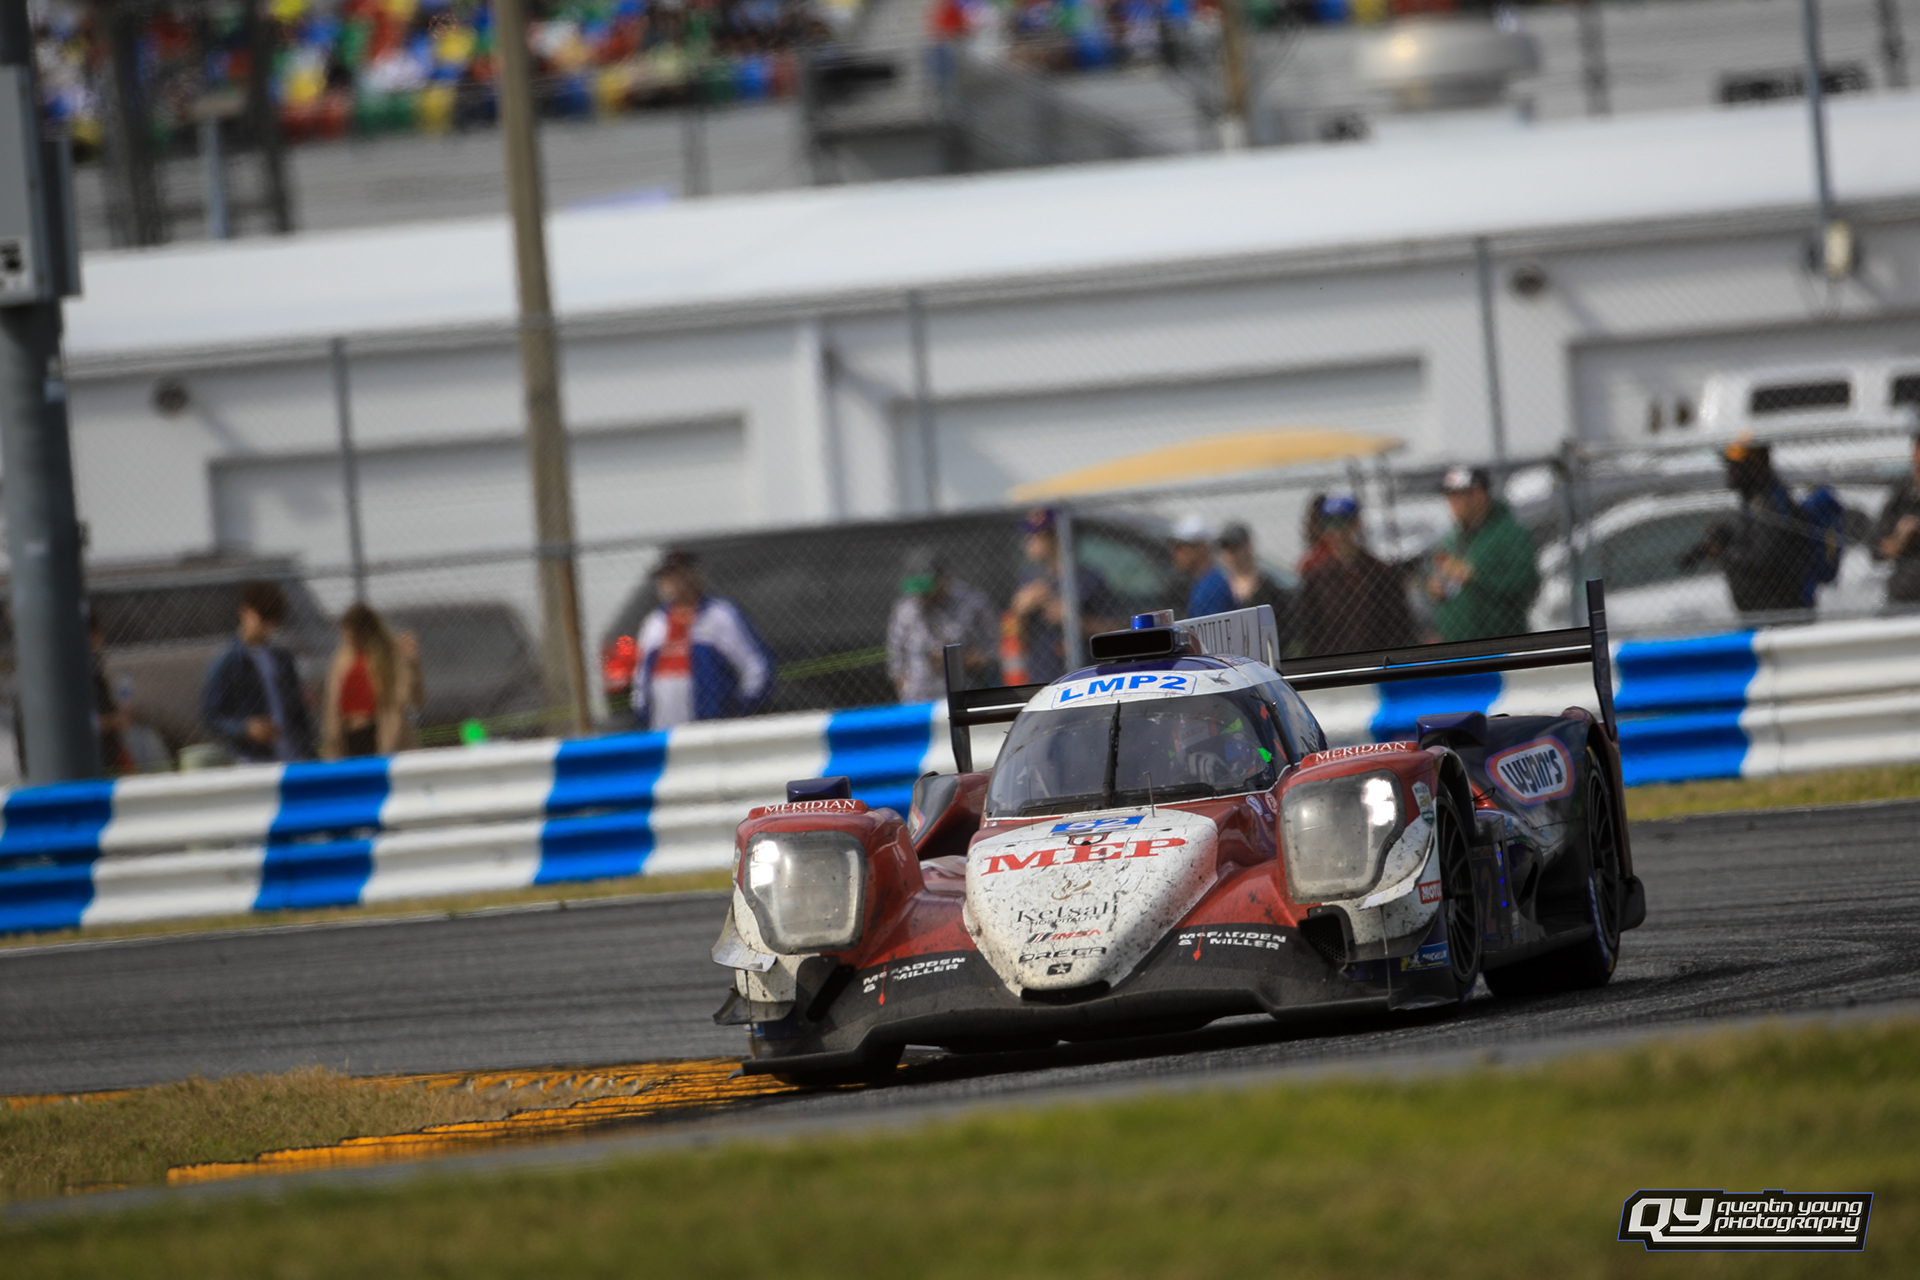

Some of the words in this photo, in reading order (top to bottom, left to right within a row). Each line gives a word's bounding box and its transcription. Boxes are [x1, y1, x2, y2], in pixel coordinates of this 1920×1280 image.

[1059, 675, 1188, 703] LMP2
[1315, 741, 1408, 761] MERIDIAN
[763, 800, 857, 814] MERIDIAN
[980, 838, 1187, 877] MEP
[1209, 938, 1280, 951] MILLER
[893, 963, 959, 982] MILLER
